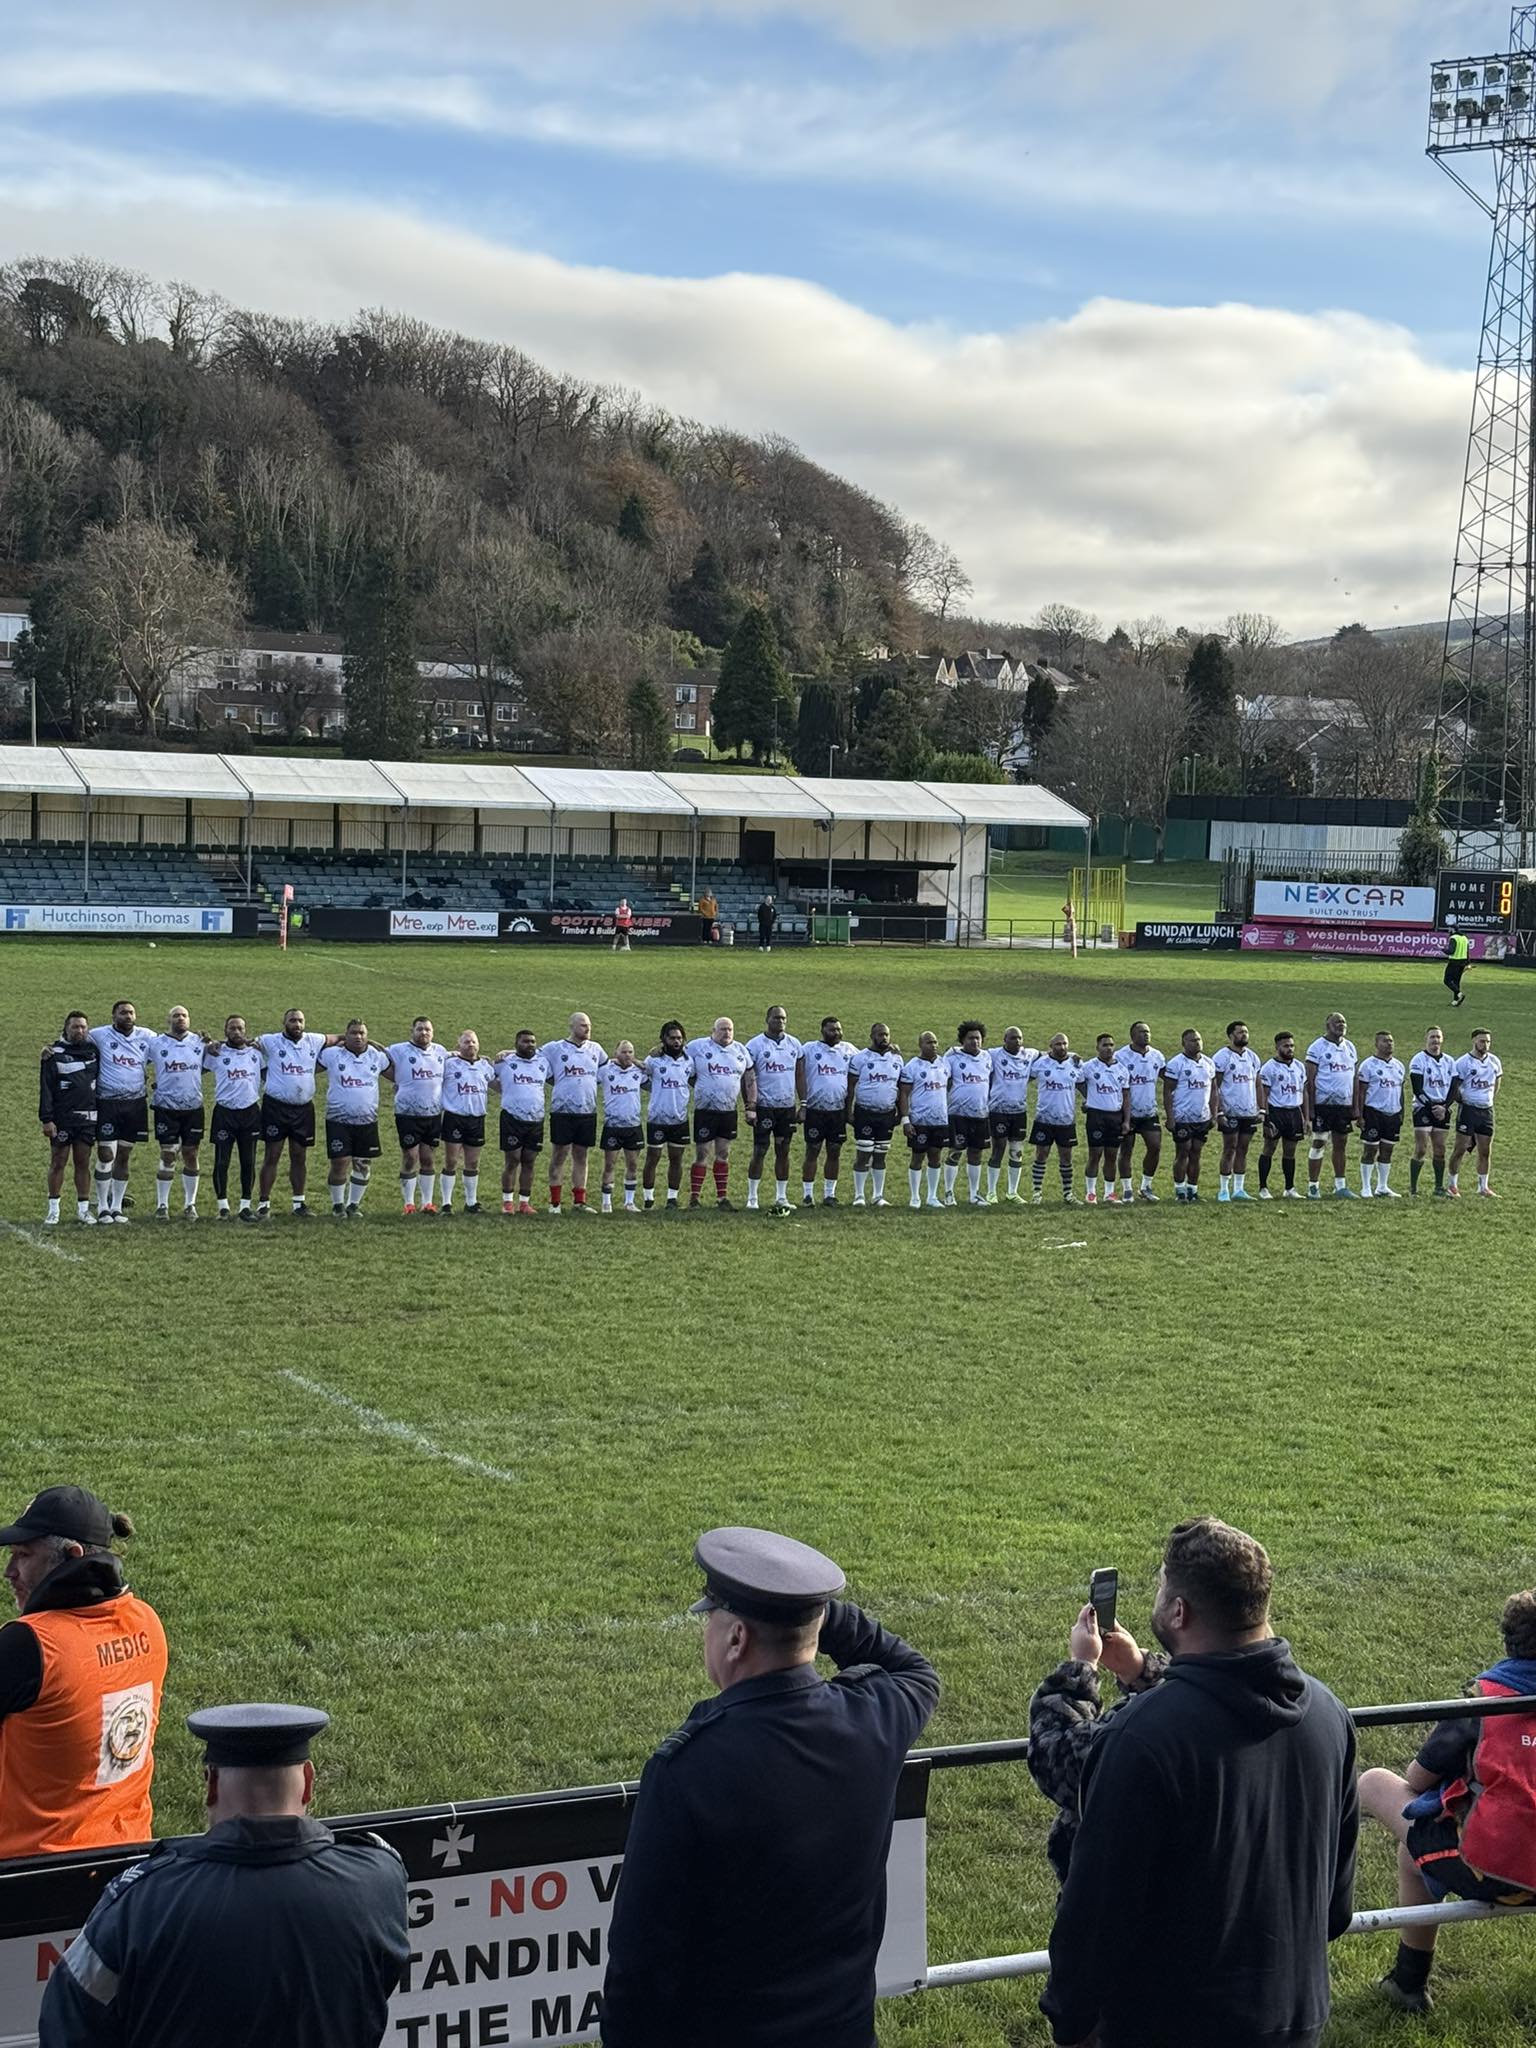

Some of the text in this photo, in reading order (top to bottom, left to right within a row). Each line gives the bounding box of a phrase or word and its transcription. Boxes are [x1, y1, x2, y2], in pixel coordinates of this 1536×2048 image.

[1450, 882, 1485, 892] HOME
[1284, 885, 1405, 906] NEXCAR
[1309, 907, 1333, 916] BUILT
[1336, 908, 1349, 916] ON
[1449, 900, 1485, 910] AWAY
[42, 908, 190, 924] Hutchinson Thomas
[1458, 914, 1504, 924] Neath RFC
[562, 927, 588, 935] Timber
[590, 927, 595, 935] &
[1144, 925, 1195, 937] SUNDAY
[1197, 926, 1234, 938] LUNCH
[1306, 930, 1475, 949] westernbayadoption.g
[97, 1631, 150, 1667] MEDIC
[490, 1871, 567, 1917] NO
[399, 1927, 601, 1994] TANDIN
[396, 1990, 605, 2048] THE MA
